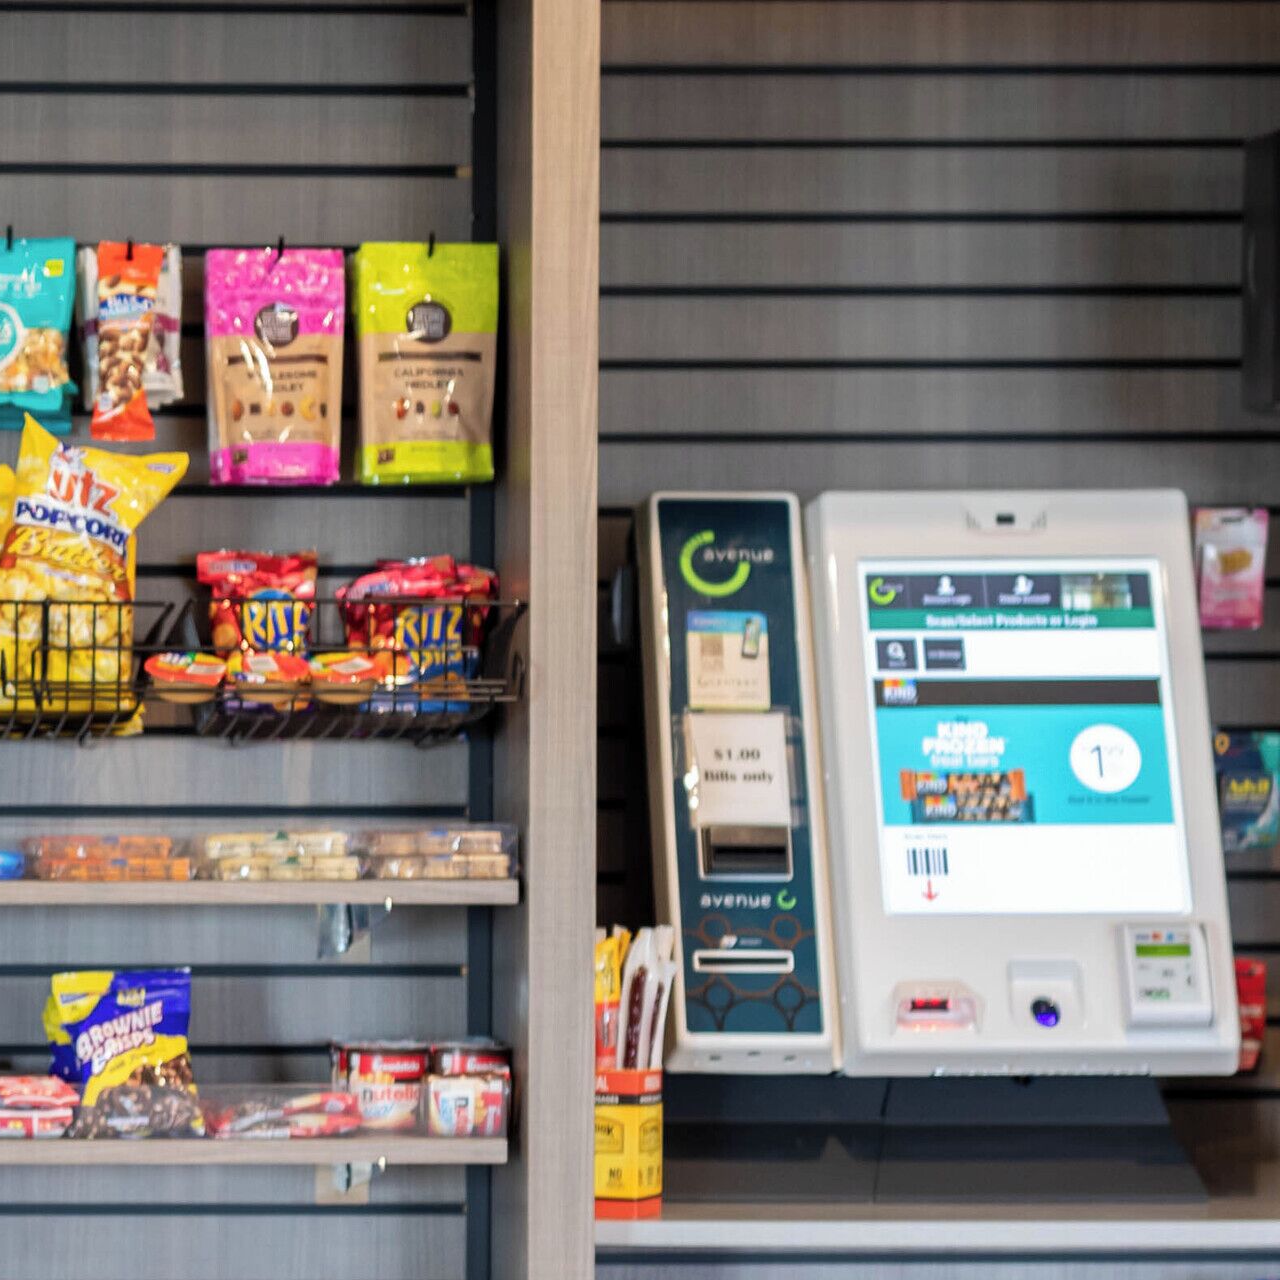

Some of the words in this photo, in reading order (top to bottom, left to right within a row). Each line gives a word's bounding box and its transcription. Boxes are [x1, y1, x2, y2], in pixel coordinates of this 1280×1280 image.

[702, 547, 775, 564] avenue
[713, 747, 761, 762] $1.00
[704, 770, 738, 783] Bills
[743, 770, 775, 785] only
[700, 892, 773, 909] avenue
